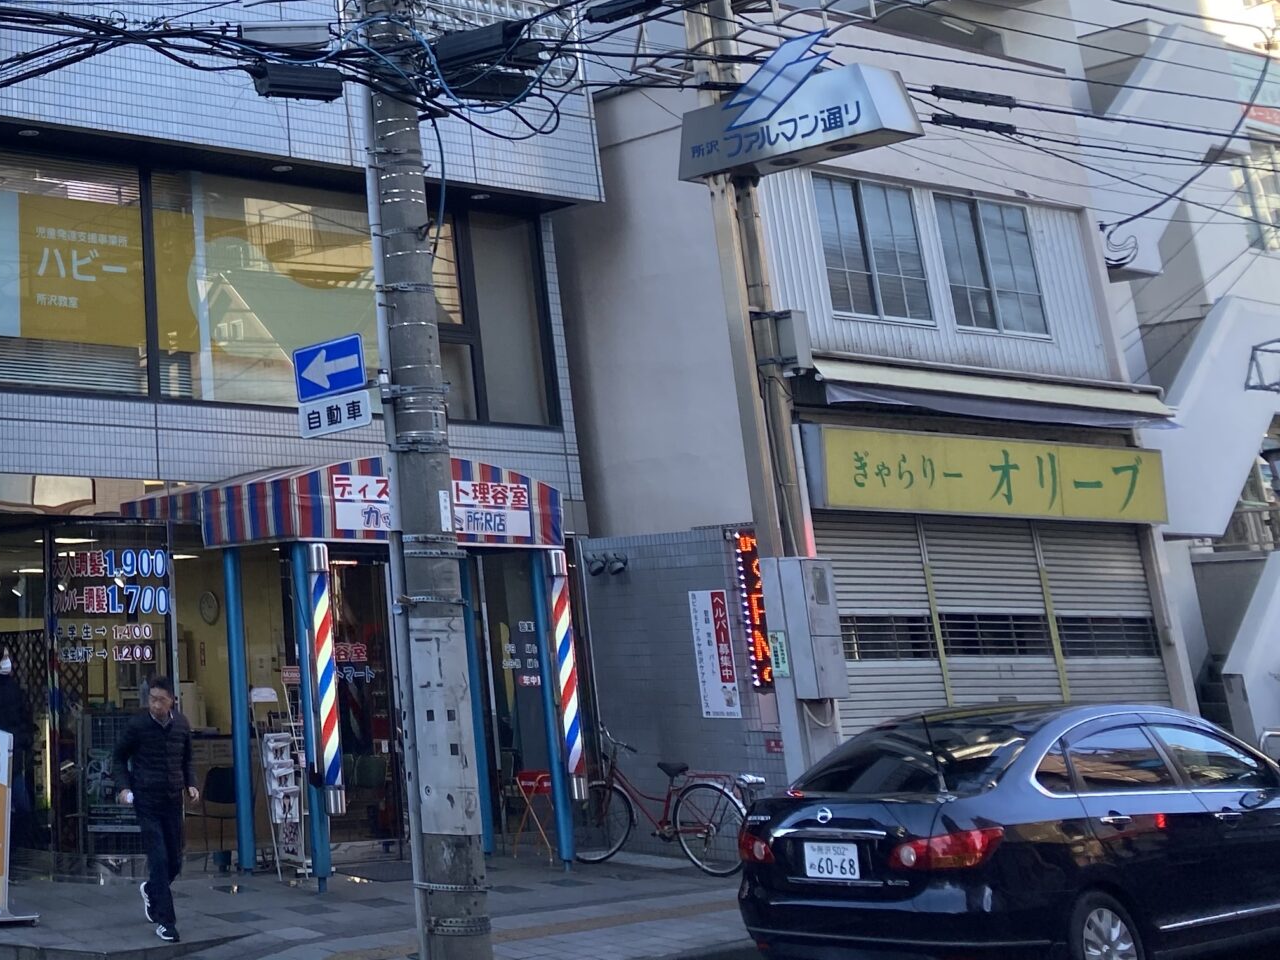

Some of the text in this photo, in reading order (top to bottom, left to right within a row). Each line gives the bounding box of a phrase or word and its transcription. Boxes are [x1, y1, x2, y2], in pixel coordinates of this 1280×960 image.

[690, 100, 862, 158] 所沢 ファルマン通り
[37, 247, 128, 282] ハビー
[307, 400, 362, 430] 自動車
[853, 449, 1143, 512] ぎゃらりー オリーブ
[466, 510, 507, 533] 所沢店
[104, 549, 172, 578] 1,900
[107, 585, 172, 615] 1,700
[335, 642, 368, 662] 容室
[713, 596, 733, 680] ヘルパー募集中
[817, 857, 856, 876] 60-68
